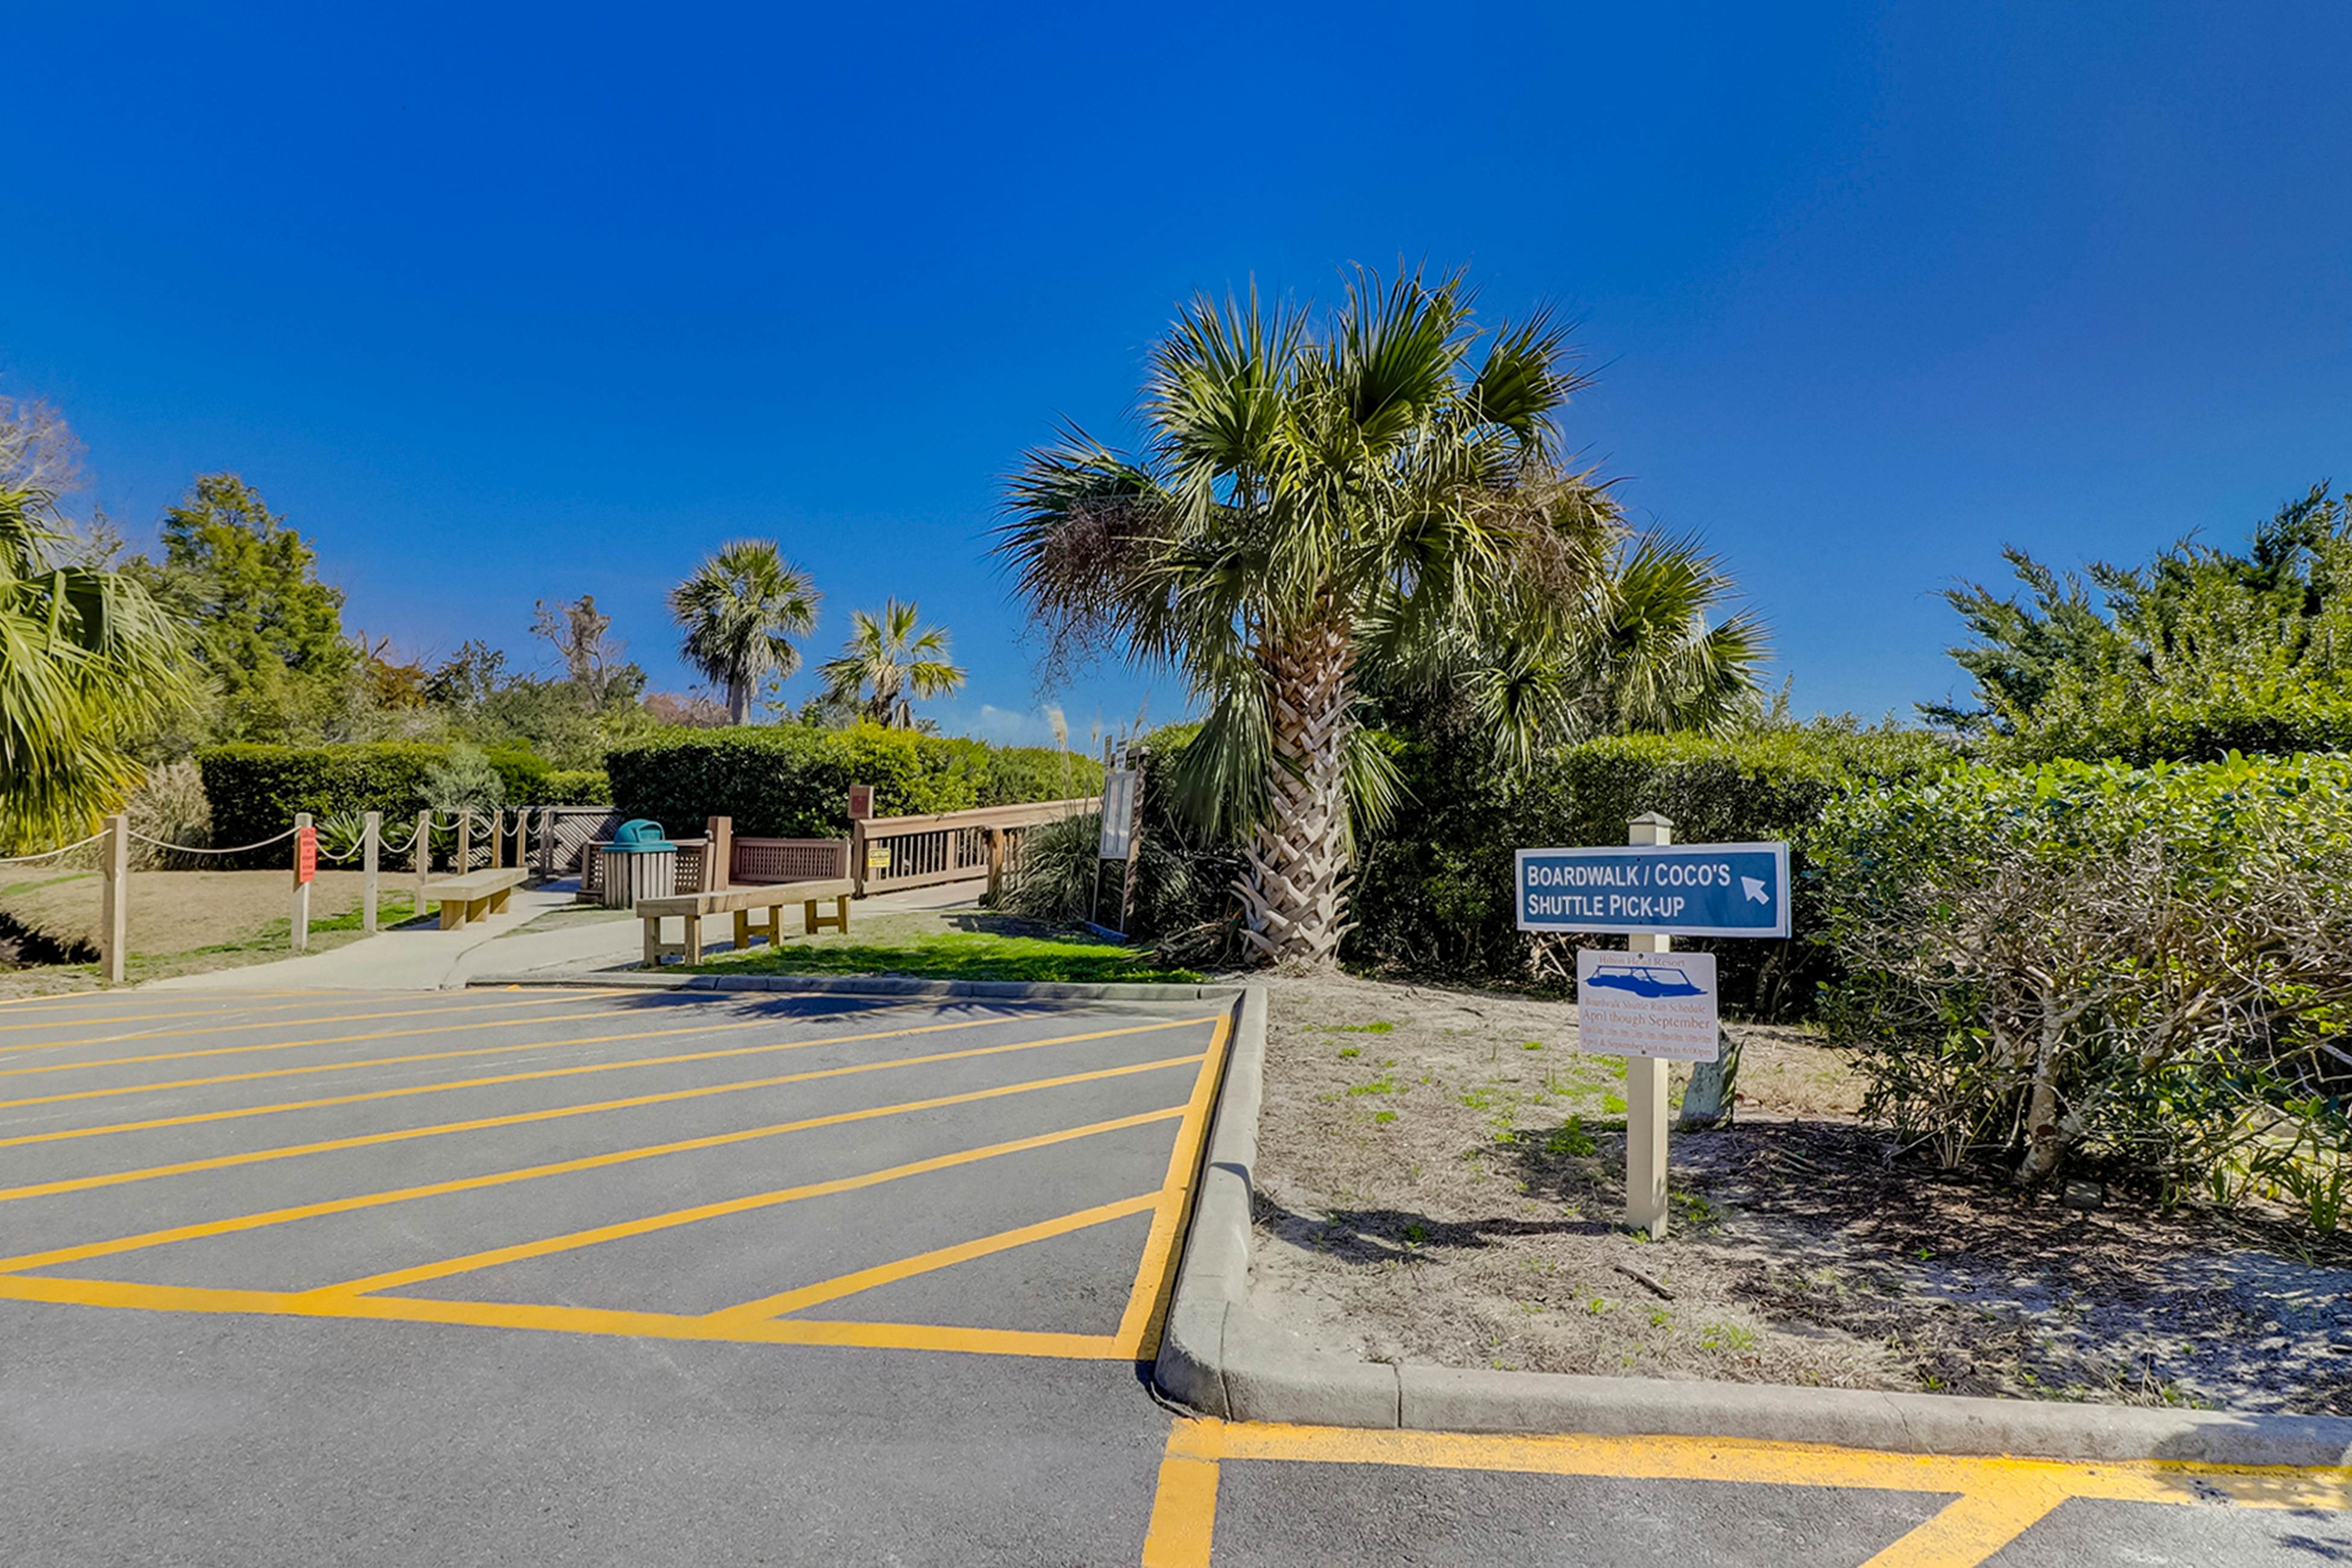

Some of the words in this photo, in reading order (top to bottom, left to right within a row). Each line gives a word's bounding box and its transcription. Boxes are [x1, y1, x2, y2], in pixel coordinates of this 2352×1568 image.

[1528, 865, 1639, 887] BOARDWALK
[1644, 865, 1650, 886] /
[1654, 863, 1730, 887] COCO'S
[1528, 893, 1604, 916] SHUTTLE
[1609, 895, 1686, 918] PICK-UP
[1599, 956, 1624, 965] Hilton
[1628, 957, 1651, 965] Head
[1654, 958, 1685, 966] Resort
[1583, 1010, 1606, 1023] April
[1610, 1012, 1645, 1027] though
[1648, 1014, 1711, 1030] September
